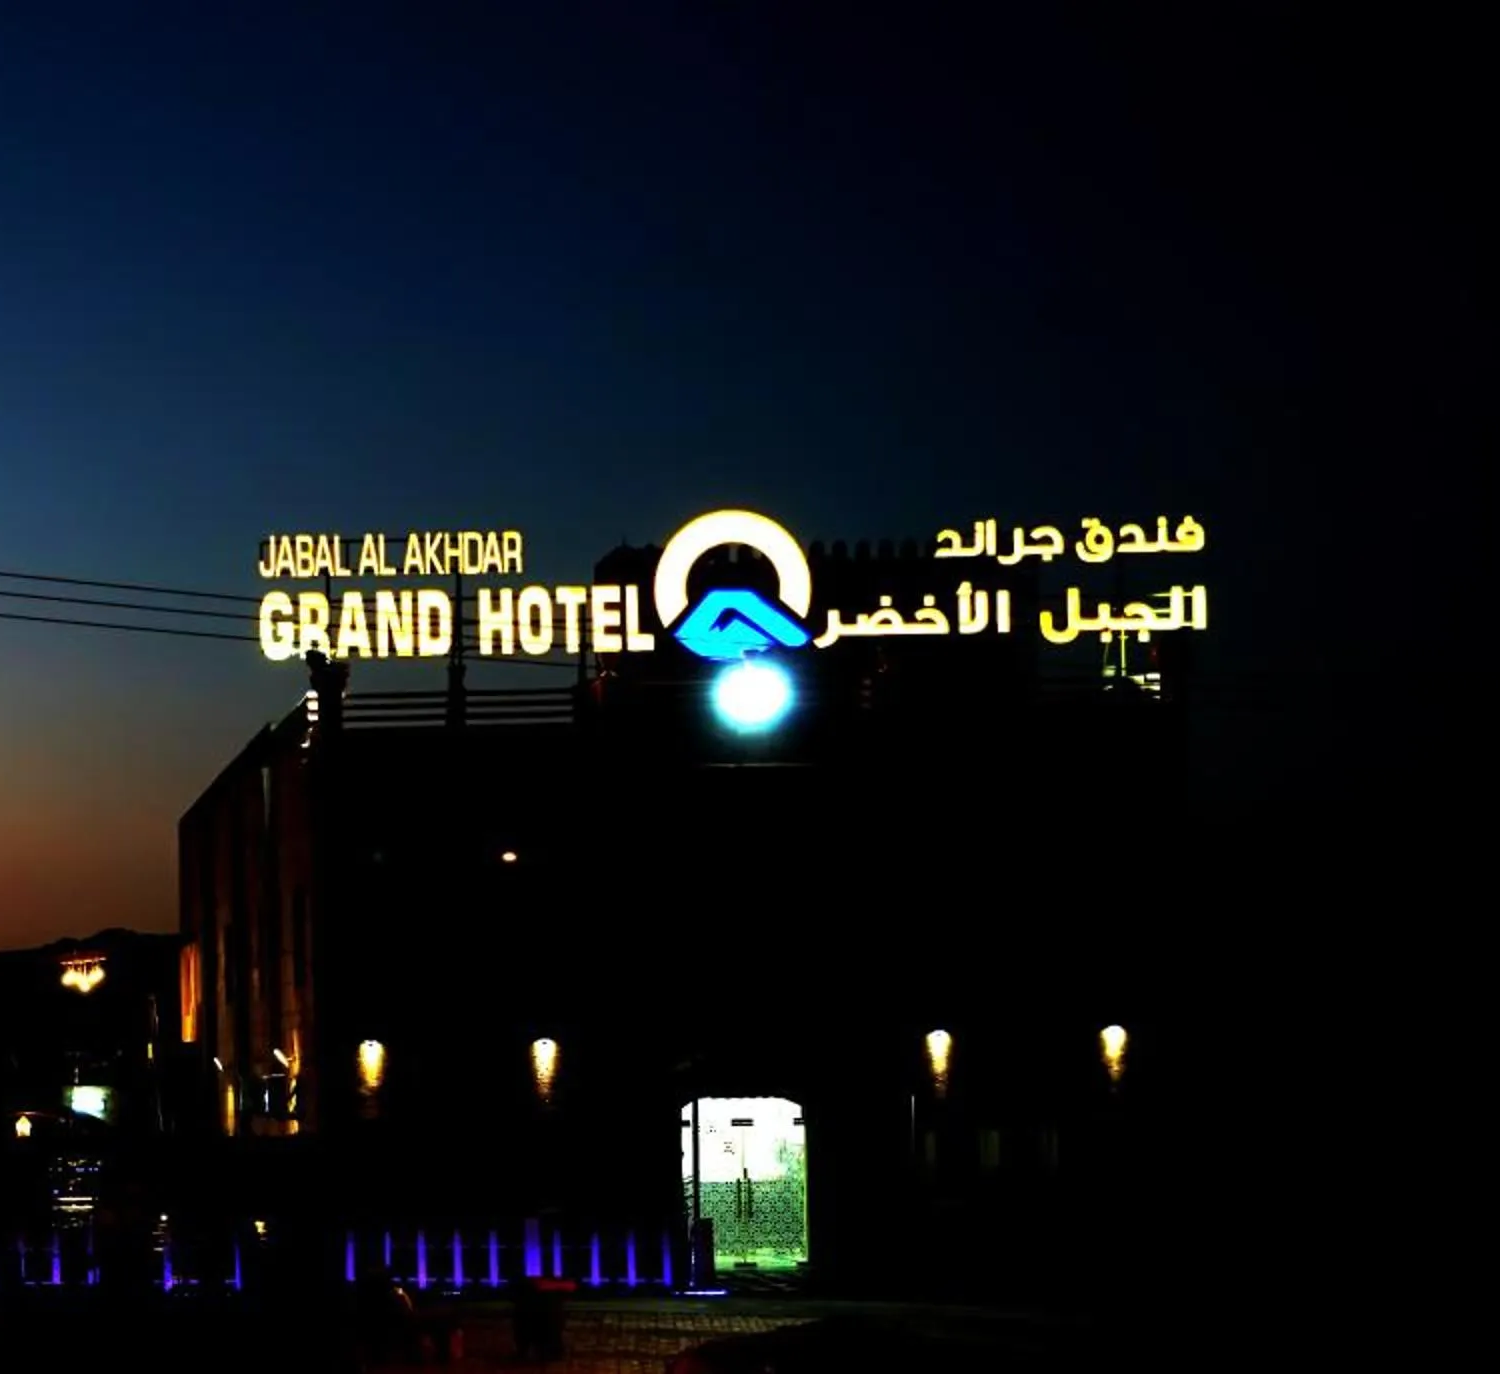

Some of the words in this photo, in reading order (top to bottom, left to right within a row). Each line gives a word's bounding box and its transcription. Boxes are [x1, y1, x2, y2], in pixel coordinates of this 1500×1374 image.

[259, 534, 351, 578] JABAL
[358, 533, 397, 577] AL
[403, 531, 523, 576] AKHDAR
[934, 518, 1065, 565] جراند
[1075, 515, 1206, 563] فندق
[259, 590, 452, 660] GRAND
[478, 584, 655, 655] HOTEL
[813, 581, 1011, 649] الأخضر
[1039, 585, 1208, 644] الجبل
